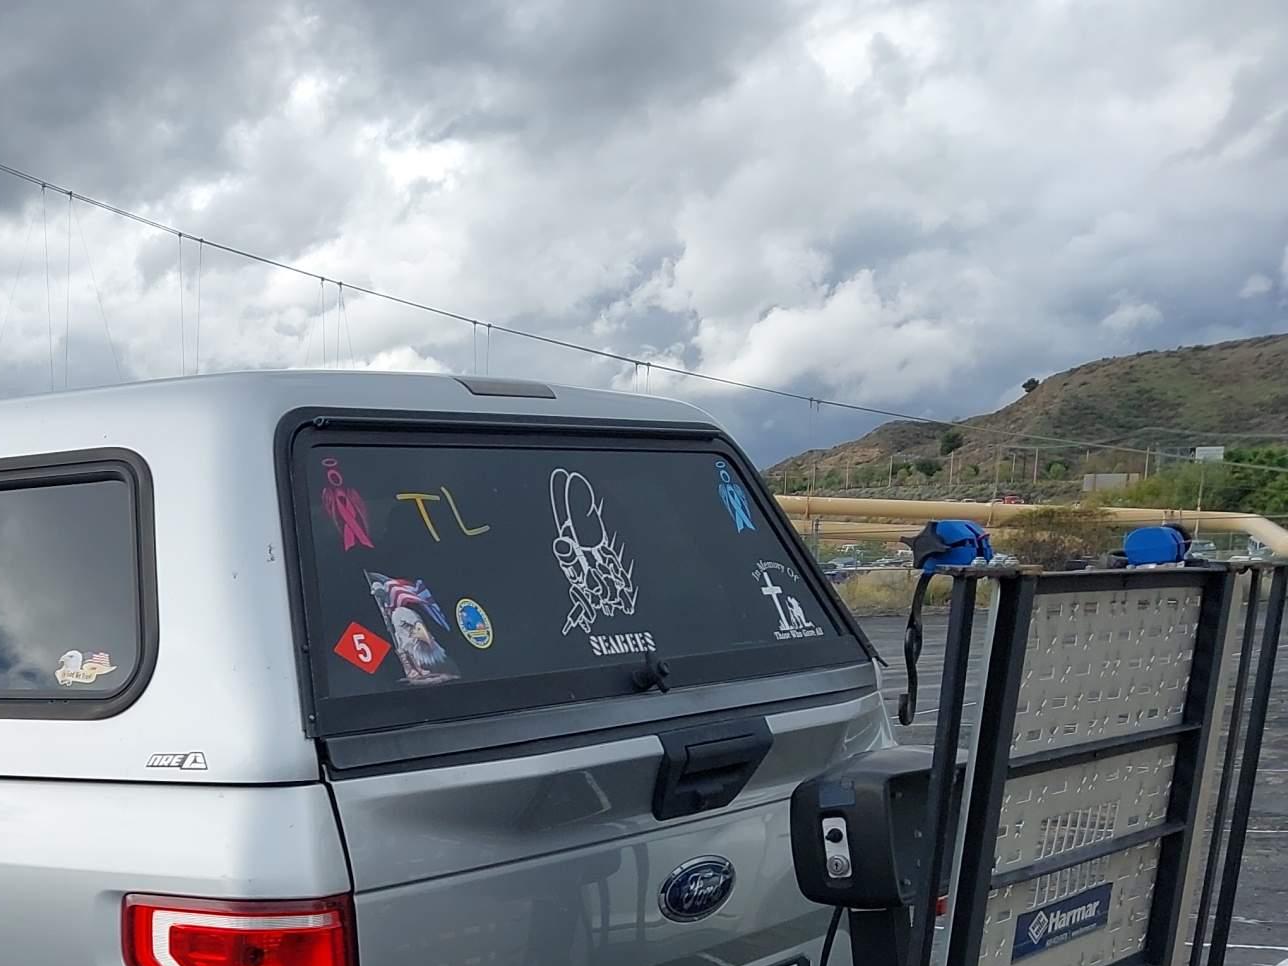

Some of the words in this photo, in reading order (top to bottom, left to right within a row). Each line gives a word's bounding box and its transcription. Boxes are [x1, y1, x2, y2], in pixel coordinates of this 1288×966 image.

[396, 486, 490, 542] TL
[352, 634, 373, 663] 5
[589, 632, 656, 656] SEABEES
[682, 869, 727, 909] Ford
[1047, 901, 1100, 933] Harmar
